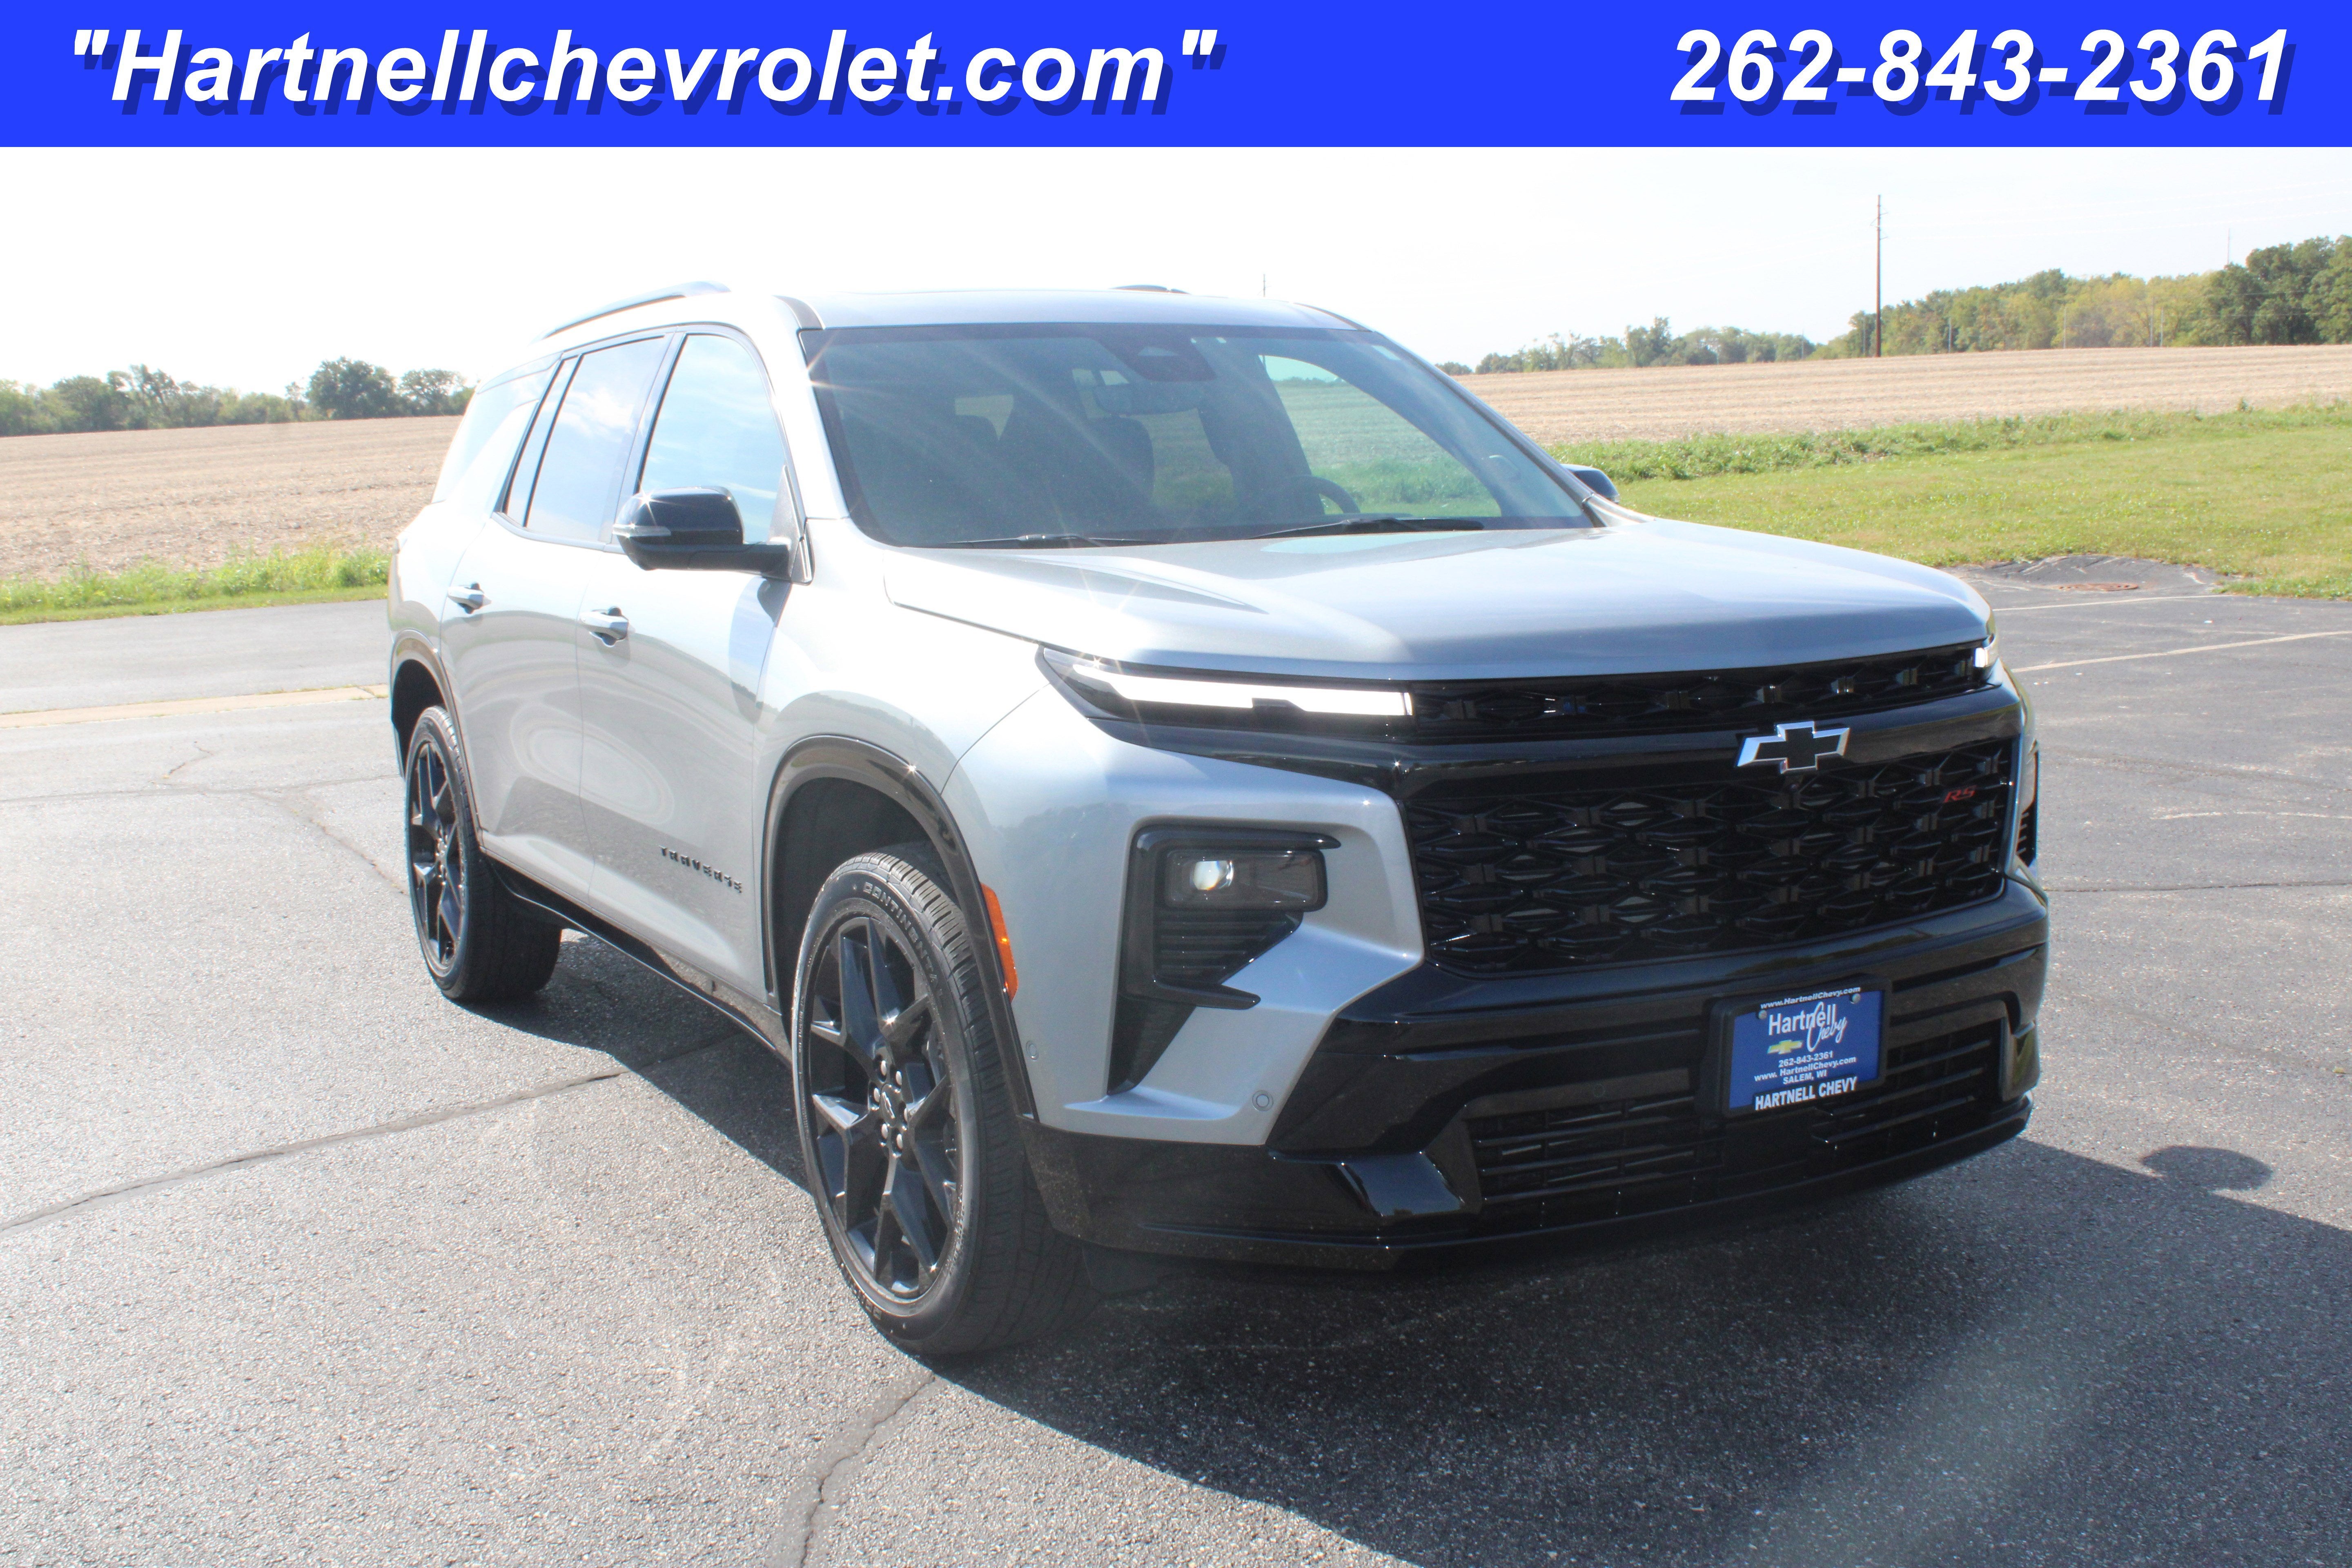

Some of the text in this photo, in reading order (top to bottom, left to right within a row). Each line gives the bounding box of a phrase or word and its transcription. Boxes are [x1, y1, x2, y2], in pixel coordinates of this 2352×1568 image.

[1944, 784, 1978, 803] RS
[1760, 987, 1860, 1009] www.HartnellChevy.com
[1768, 1003, 1837, 1036] Hartnell
[1806, 1001, 1847, 1052] Chevy
[1778, 1050, 1833, 1067] 262-843-2361
[1780, 1056, 1856, 1076] HartnellChevy.com
[1783, 1069, 1827, 1085] SALEM, WI
[1755, 1076, 1857, 1110] HARTNELL CHEVY
